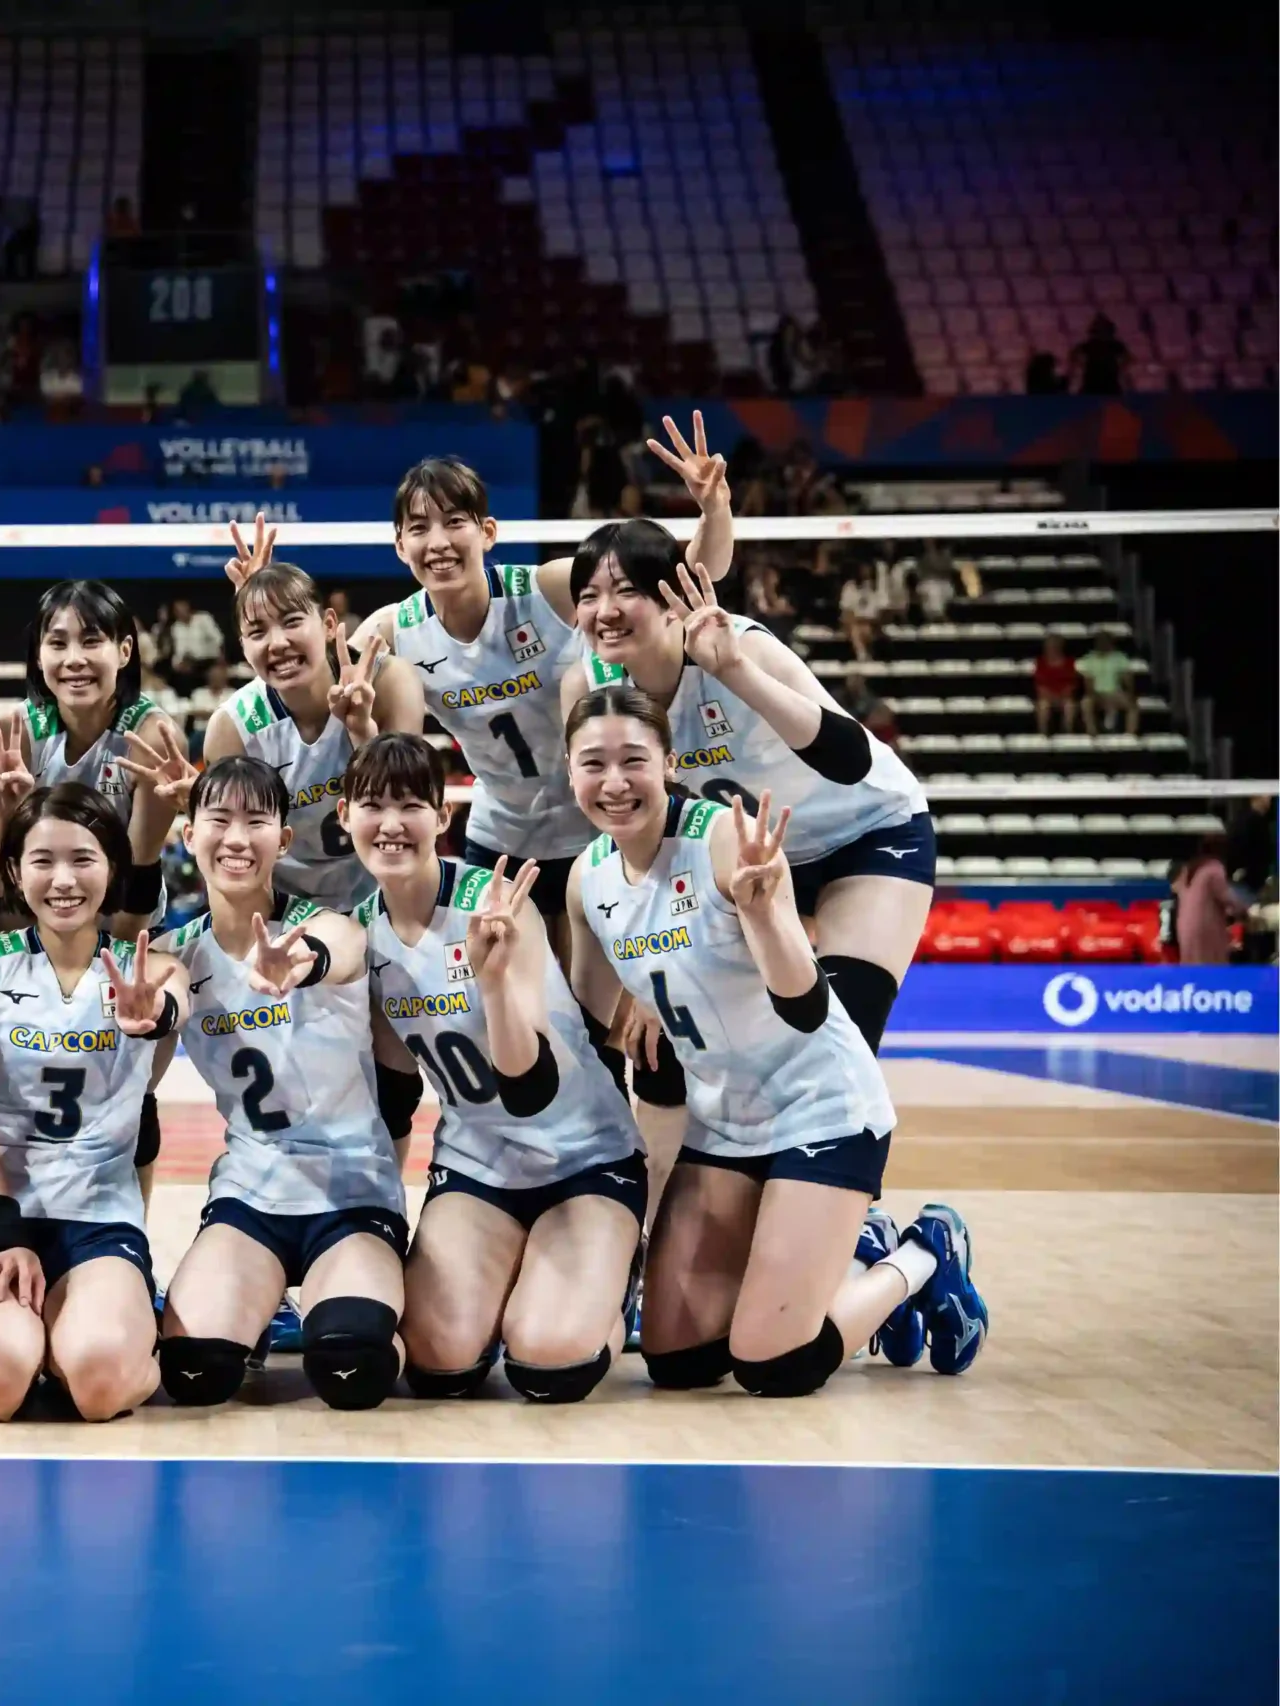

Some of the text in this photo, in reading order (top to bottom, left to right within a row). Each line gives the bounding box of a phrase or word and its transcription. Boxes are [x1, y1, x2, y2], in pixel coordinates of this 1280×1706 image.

[520, 644, 539, 659] JPN
[442, 671, 542, 709] CAPCOM
[488, 712, 540, 778] 1
[675, 745, 735, 772] COM
[288, 774, 346, 809] APC
[675, 900, 694, 912] JPN
[613, 926, 692, 960] CAPCOM
[385, 992, 470, 1018] CAPCOM
[649, 970, 707, 1051] 4
[1104, 983, 1253, 1013] vodafone
[201, 1002, 291, 1037] CAPCOM
[9, 1026, 117, 1052] CAPCOM
[404, 1031, 499, 1107] 10
[33, 1066, 87, 1140] 3
[231, 1047, 291, 1131] 2
